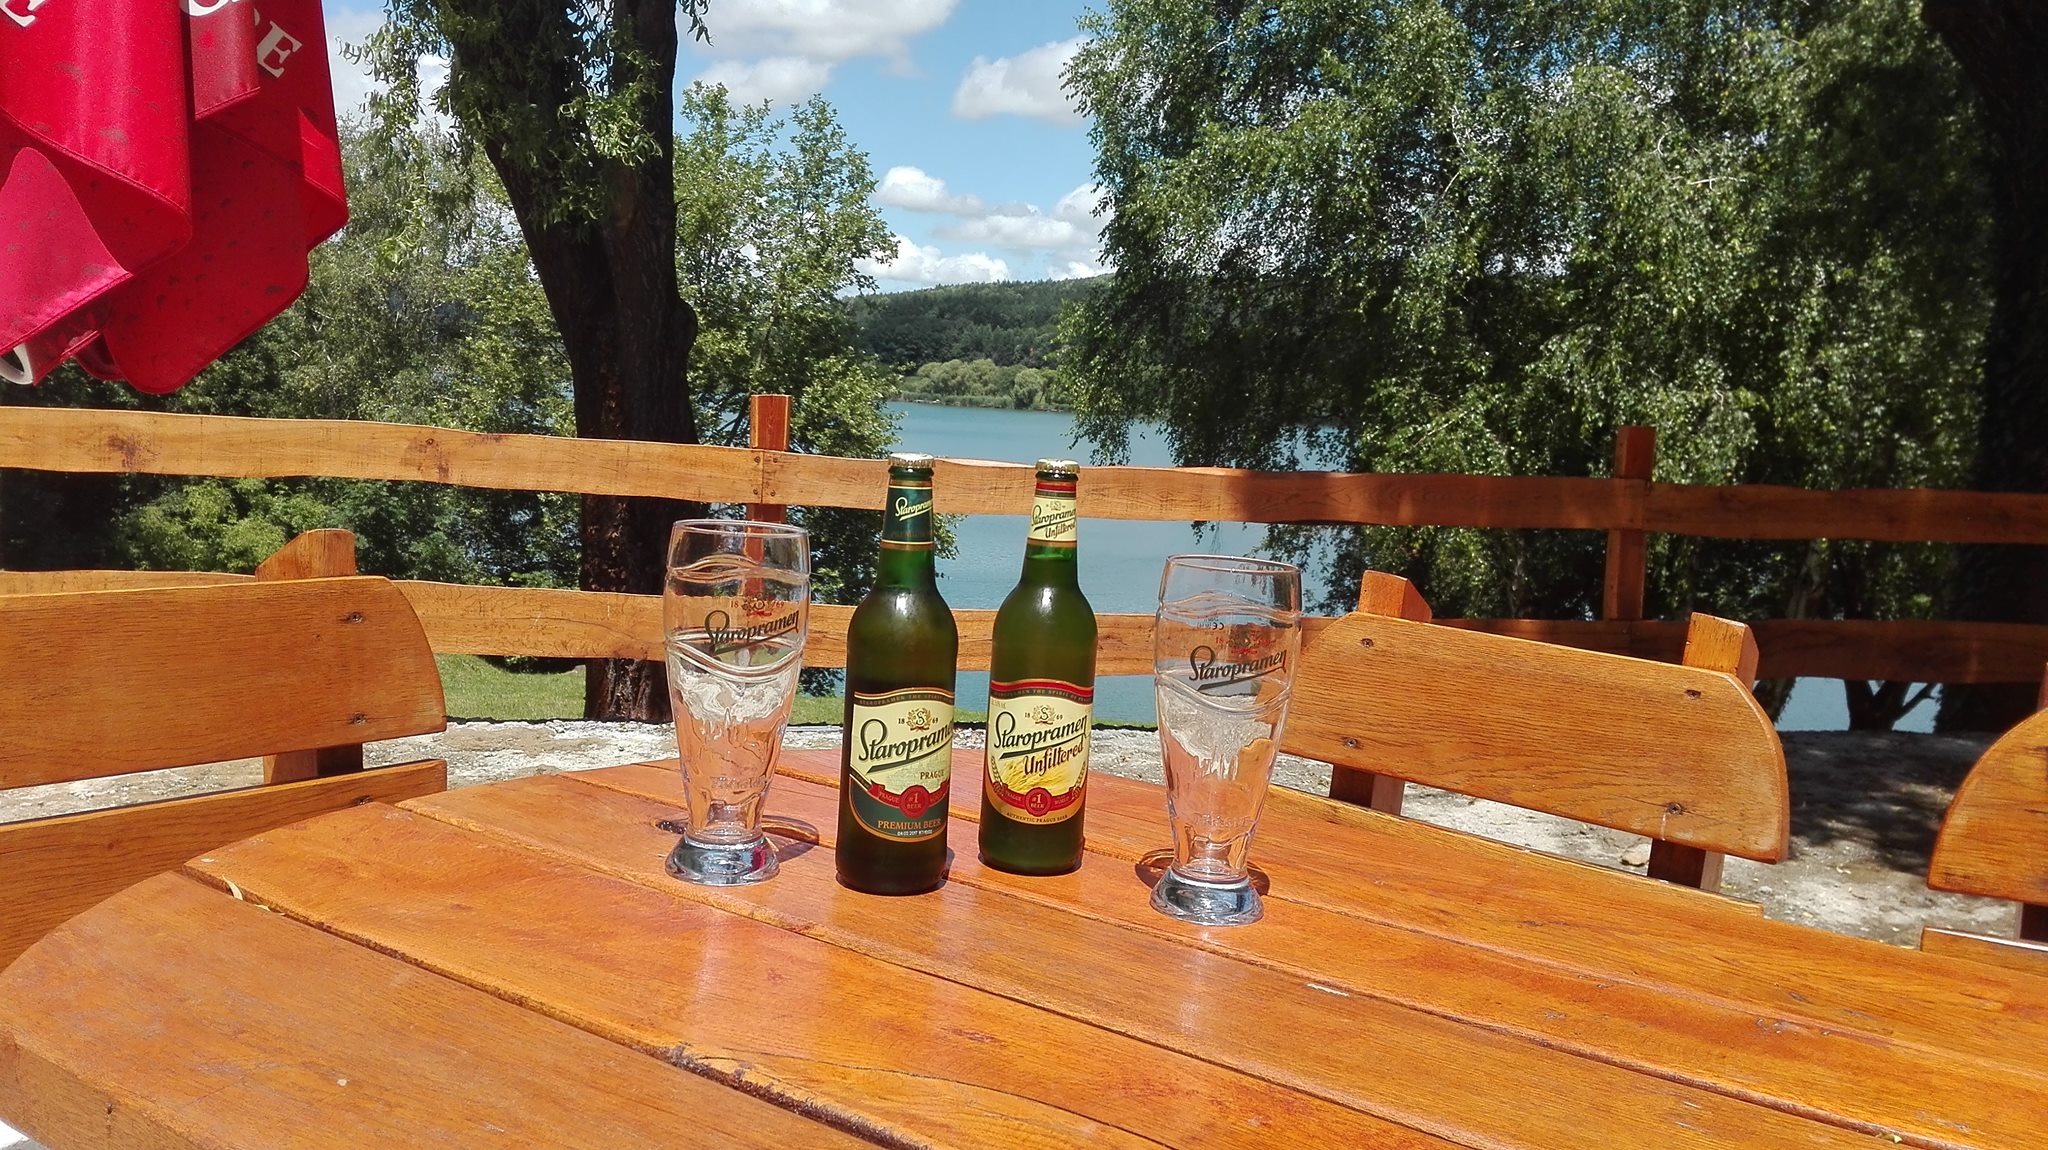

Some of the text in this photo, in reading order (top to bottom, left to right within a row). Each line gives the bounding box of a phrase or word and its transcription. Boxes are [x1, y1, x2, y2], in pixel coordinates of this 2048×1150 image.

[705, 610, 799, 648] Staropramen
[1189, 645, 1287, 681] Staropramen
[898, 717, 906, 725] 18
[994, 711, 1088, 750] Staropramen
[1024, 736, 1084, 776] Unfiltered
[920, 769, 945, 780] PRAGUE
[877, 820, 921, 830] PREMIUM
[1006, 812, 1034, 822] AUTHENTIC
